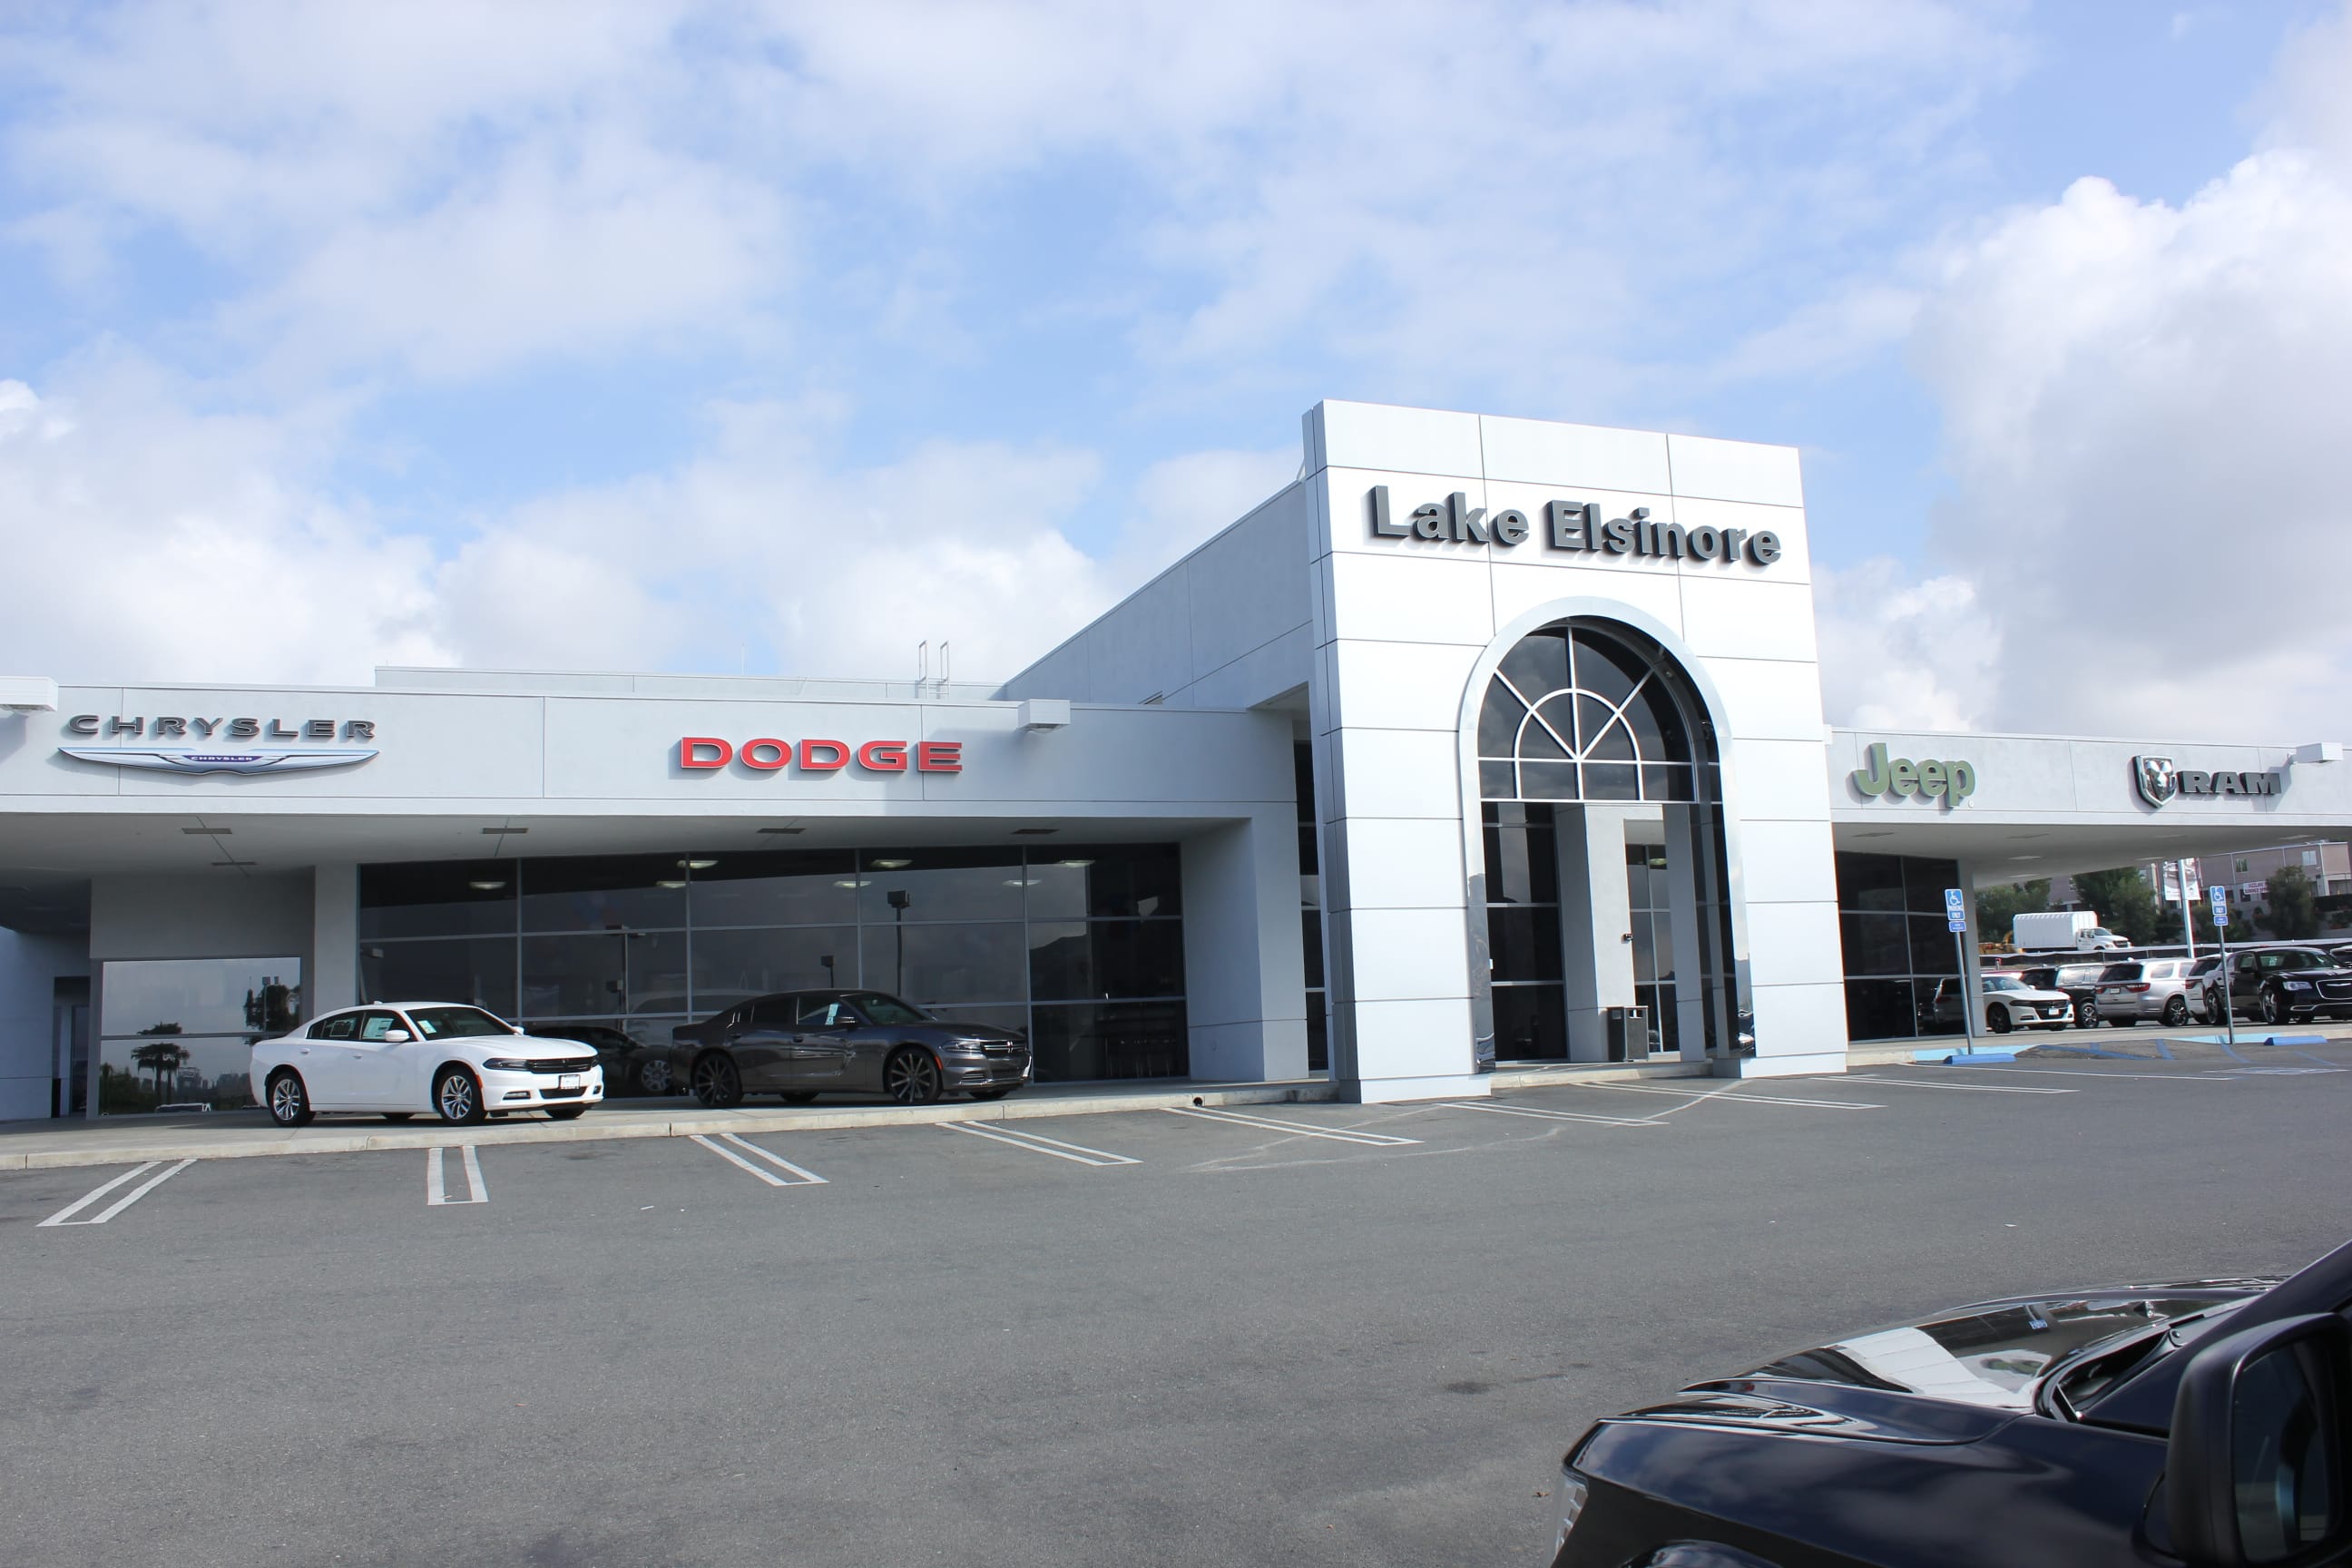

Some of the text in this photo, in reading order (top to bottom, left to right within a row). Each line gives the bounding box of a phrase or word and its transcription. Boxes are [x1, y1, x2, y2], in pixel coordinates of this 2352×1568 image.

[1370, 485, 1781, 565] Lake Elsinore
[68, 714, 376, 739] CHRYSLER
[681, 736, 963, 772] DODGE
[1851, 742, 1975, 808] Jeep
[2179, 771, 2282, 795] RAM
